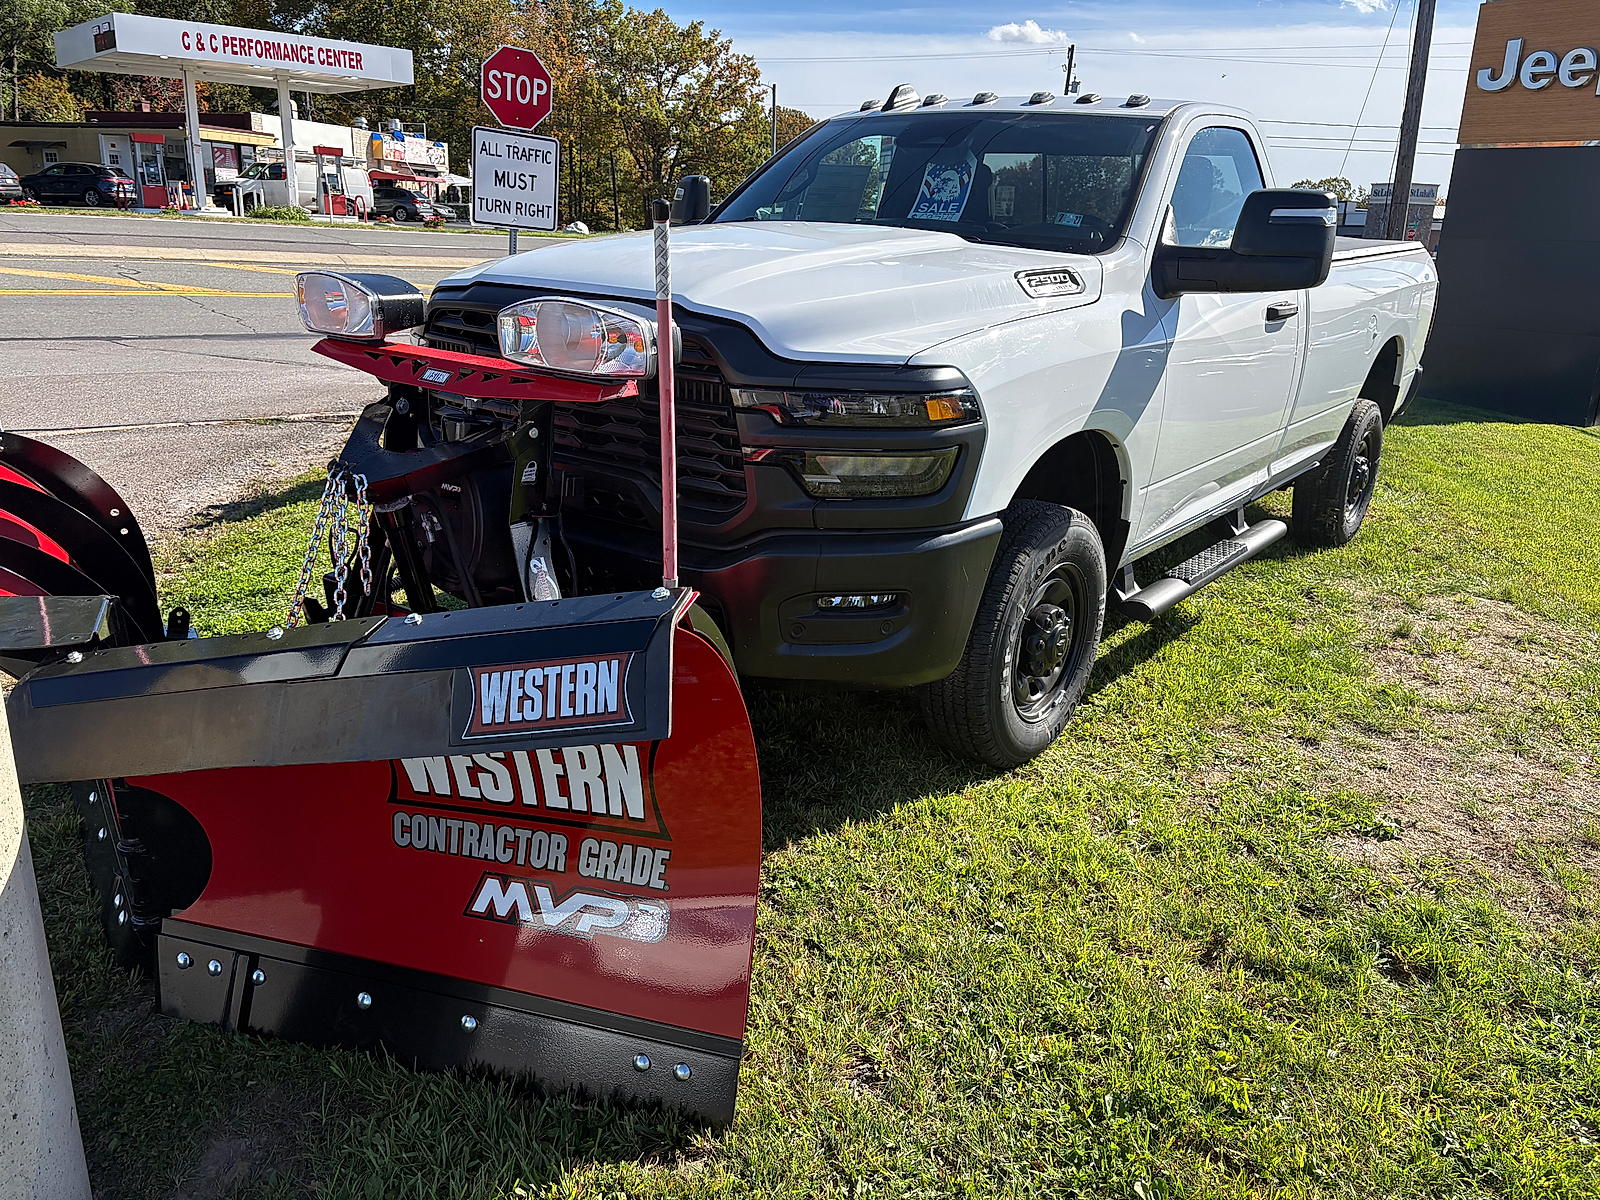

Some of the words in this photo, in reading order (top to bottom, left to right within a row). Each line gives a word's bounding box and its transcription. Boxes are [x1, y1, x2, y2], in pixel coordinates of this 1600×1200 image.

[181, 31, 191, 51] C
[195, 32, 206, 52] &
[209, 34, 219, 53] C
[221, 35, 315, 65] PERFORMANCE
[317, 47, 363, 71] CENTER
[1476, 37, 1600, 97] Jee
[486, 69, 548, 106] STOP
[479, 140, 503, 158] ALL
[505, 144, 553, 165] TRAFFIC
[494, 169, 538, 192] MUST
[477, 196, 512, 215] TURN
[515, 201, 553, 219] RIGHT
[917, 202, 960, 213] SALE
[1028, 272, 1070, 287] 2500
[480, 659, 620, 725] WESTERN
[401, 743, 645, 819] WESTERN
[393, 811, 569, 875] CONTRACTOR
